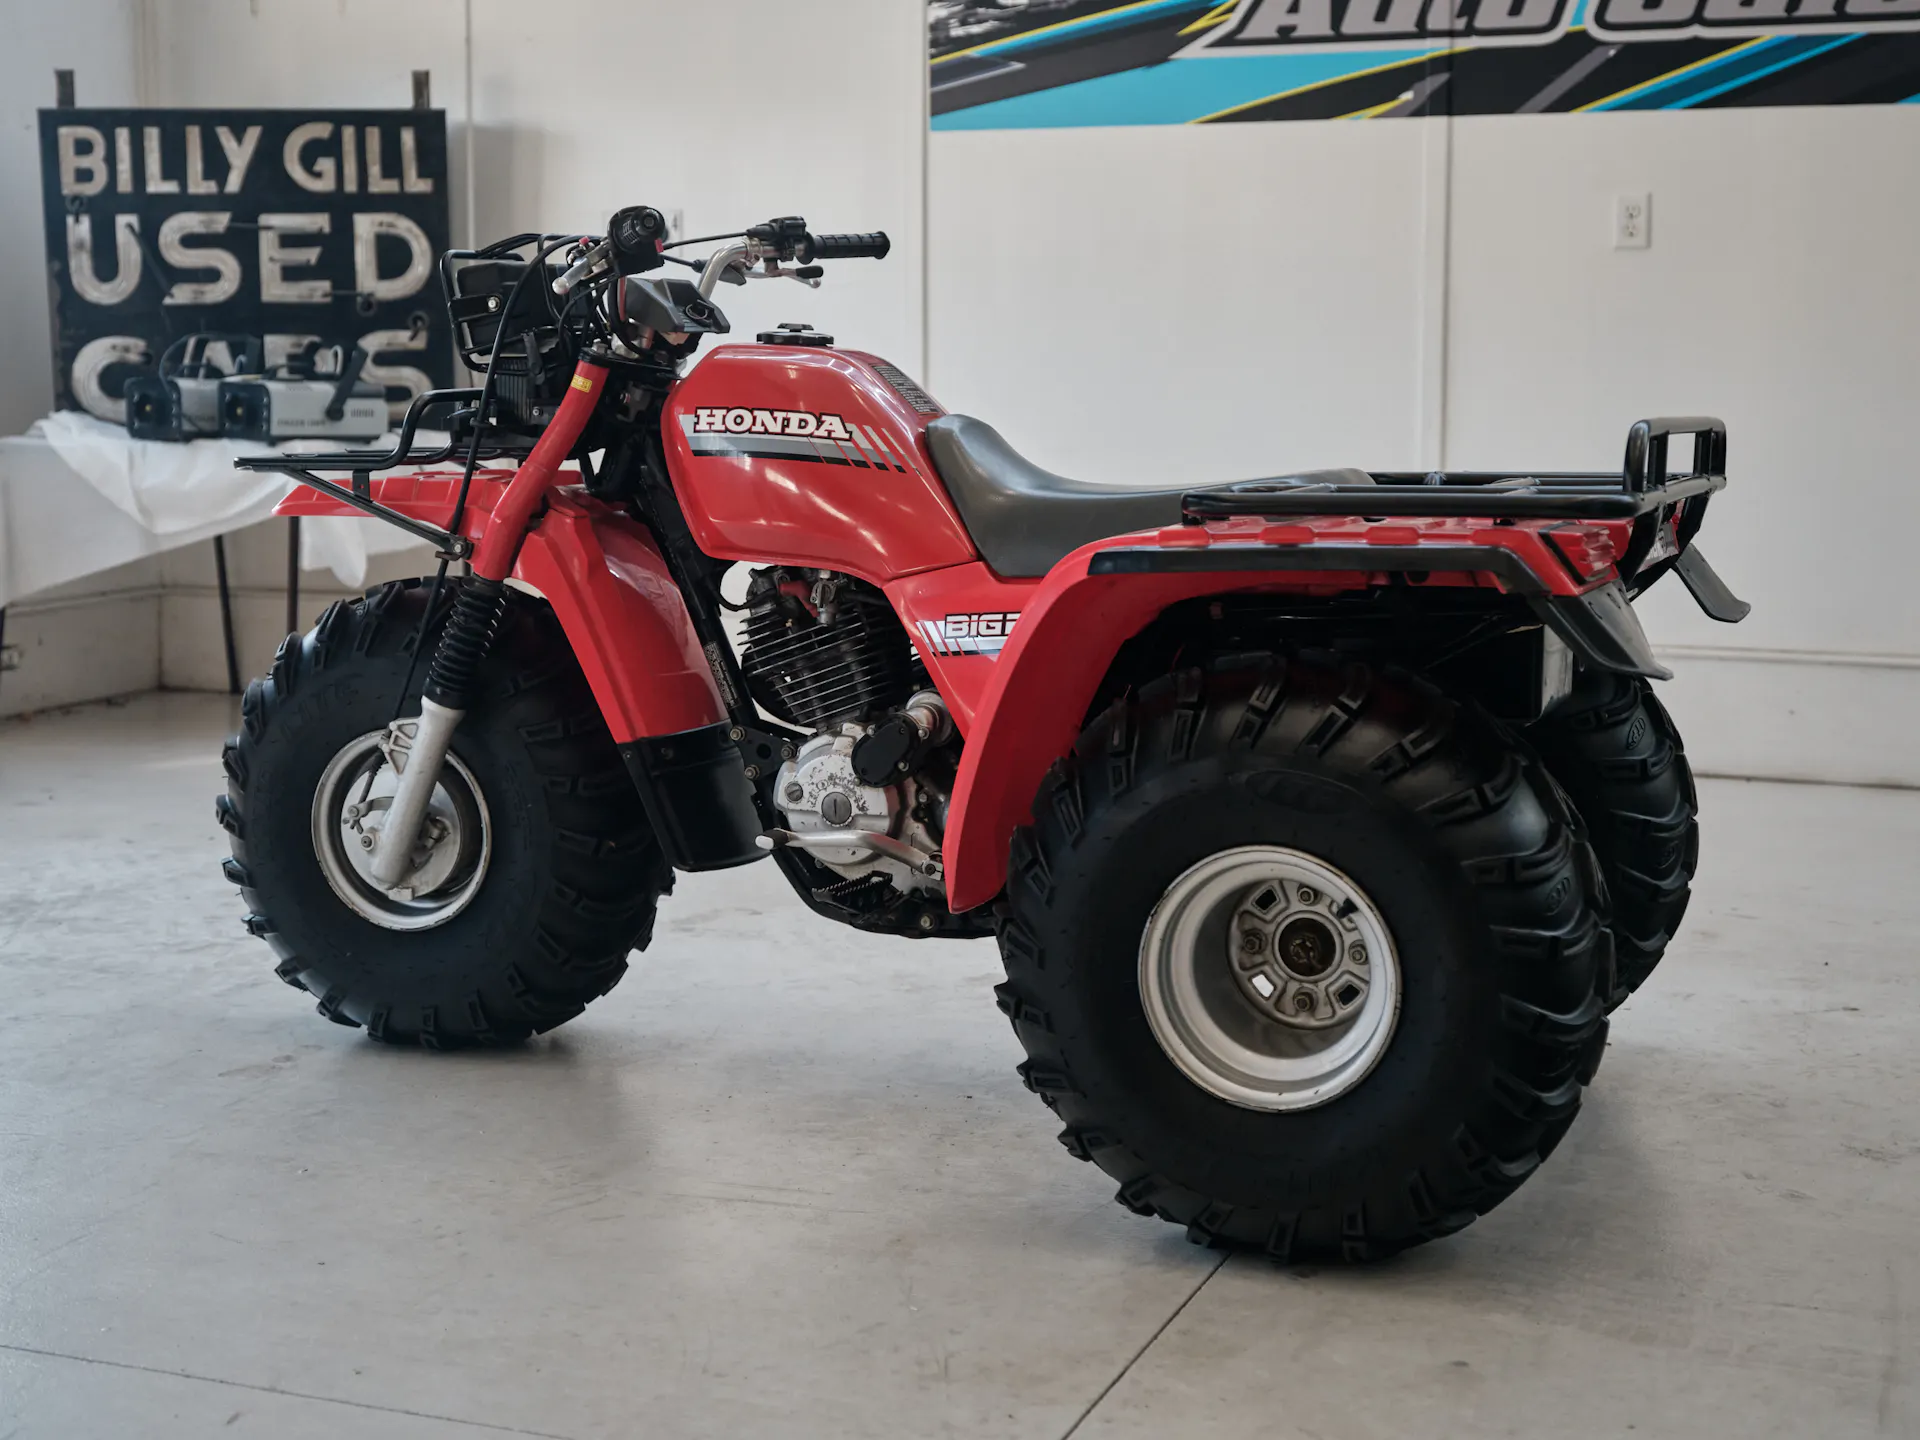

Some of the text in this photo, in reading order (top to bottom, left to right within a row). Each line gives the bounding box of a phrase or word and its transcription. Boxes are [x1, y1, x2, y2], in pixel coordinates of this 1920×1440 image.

[57, 122, 434, 196] BILLY GILL
[66, 211, 433, 305] USED
[694, 407, 852, 440] HONDA
